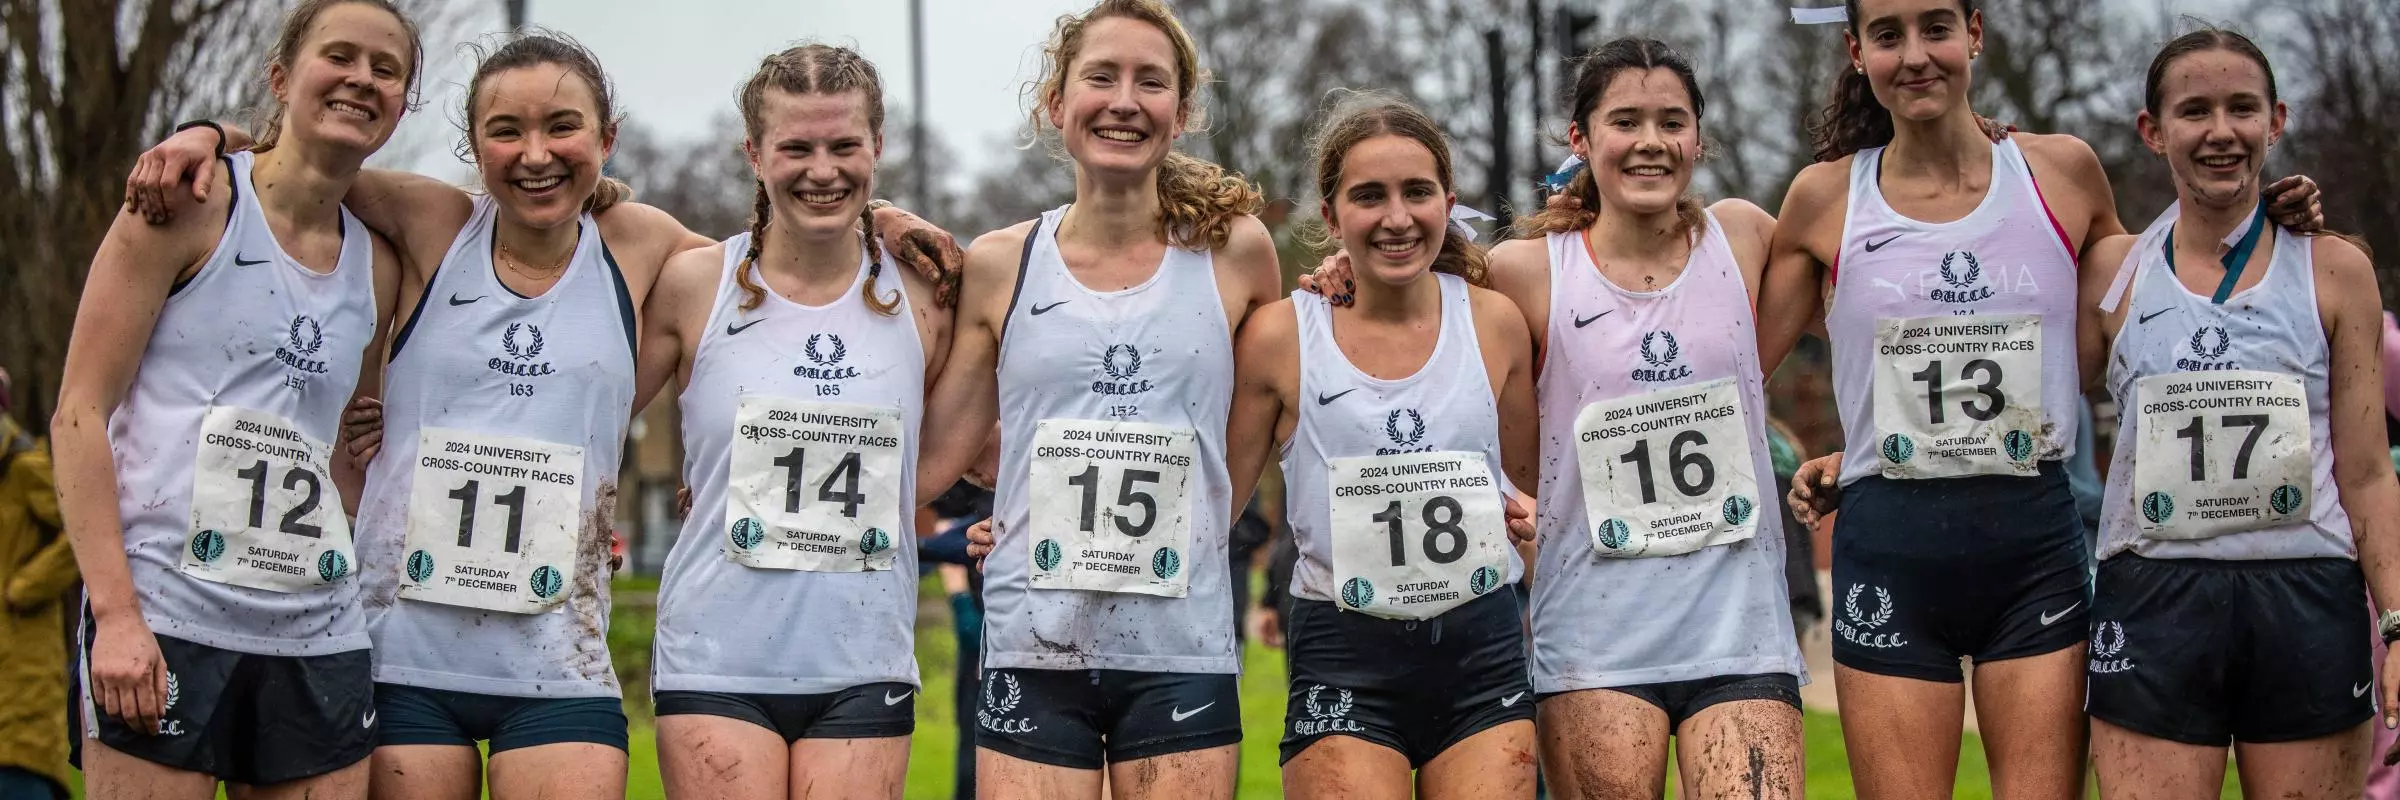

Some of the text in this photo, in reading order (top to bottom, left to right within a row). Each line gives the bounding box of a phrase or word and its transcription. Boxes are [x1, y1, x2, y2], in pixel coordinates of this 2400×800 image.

[1919, 264, 2040, 297] PMA
[1903, 324, 2009, 339] 2024 UNIVERSITY
[1992, 340, 2035, 353] RACES
[509, 383, 534, 397] 163
[815, 384, 841, 396] 165
[1912, 358, 2006, 425] 13
[2166, 380, 2273, 395] 2024 UNIVERSITY
[1110, 405, 1138, 417] 152
[1604, 393, 1708, 422] 2024 UNIVERSITY
[2144, 396, 2301, 415] CROSS-COUNTRY RACES
[768, 410, 878, 429] 2024 UNIVERSITY
[1581, 405, 1735, 443] CROSS-COUNTRY RACES
[235, 420, 313, 454] 2024 UNIVE
[858, 436, 898, 448] RACES
[1063, 430, 1172, 447] 2024 UNIVERSITY
[1935, 436, 1987, 447] SATURDAY
[206, 434, 311, 462] CROSS-COUNTRY
[445, 441, 551, 464] 2024 UNIVERSITY
[1927, 447, 1997, 459] 7th DECEMBER
[2176, 414, 2270, 482] 17
[1037, 447, 1190, 467] CROSS-COUNTRY RACES
[421, 456, 575, 485] CROSS-COUNTRY RACES
[1360, 461, 1462, 479] 2024 UNIVERSITY
[1620, 429, 1715, 505] 16
[773, 447, 865, 518] 14
[1335, 476, 1489, 497] CROSS-COUNTRY RACES
[237, 459, 322, 539] 12
[1068, 465, 1161, 538] 15
[2195, 497, 2250, 508] SATURDAY
[448, 479, 526, 554] 11
[1650, 512, 1703, 529] SATURDAY
[2187, 507, 2260, 520] 7th DECEMBER
[786, 530, 841, 543] SATURDAY
[1372, 495, 1468, 567] 18
[1643, 521, 1714, 541] 7th DECEMBER
[248, 546, 300, 563] SATURDAY
[776, 541, 847, 555] 7th DECEMBER
[1081, 549, 1135, 562] SATURDAY
[237, 557, 306, 576] 7th DECEMBER
[454, 565, 510, 579] SATURDAY
[1072, 561, 1141, 575] 7th DECEMBER
[444, 576, 517, 593] 7th DECEMBER
[1396, 580, 1450, 593] SATURDAY
[1388, 592, 1460, 605] 7th DECEMBER
